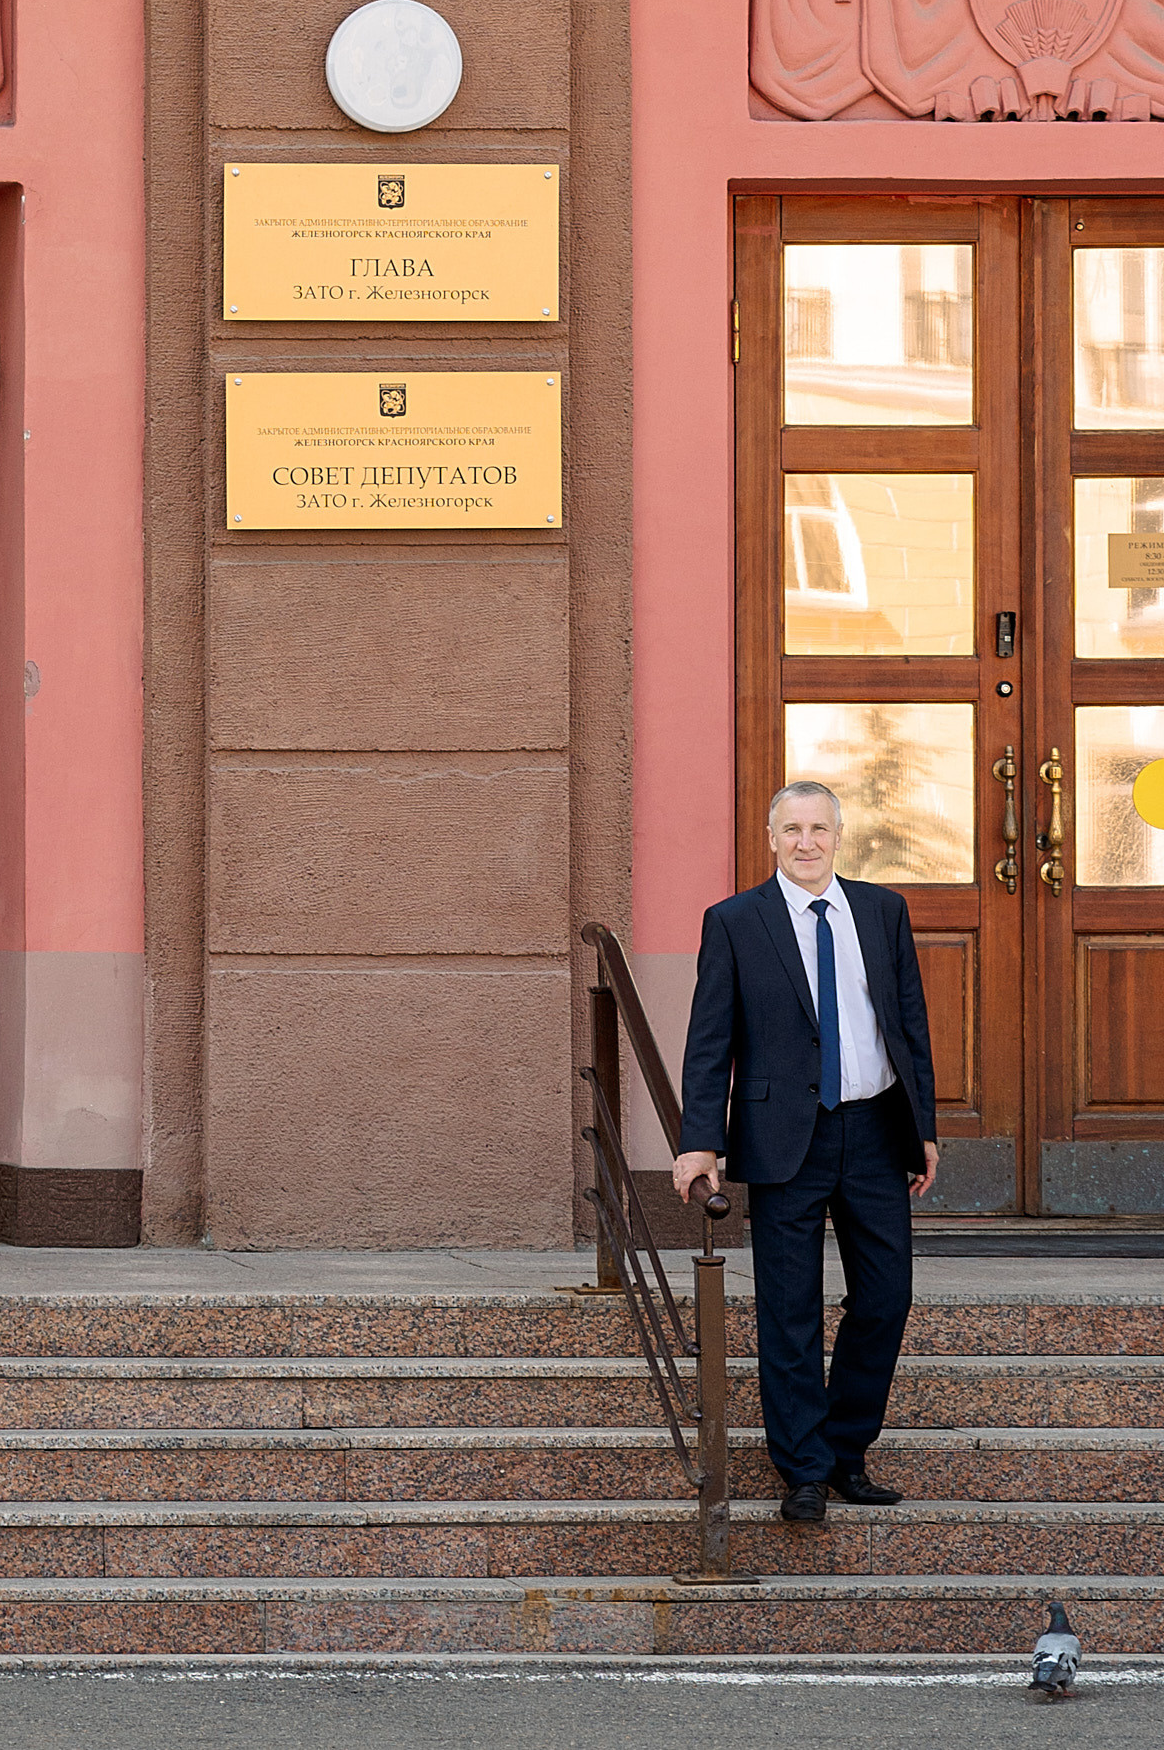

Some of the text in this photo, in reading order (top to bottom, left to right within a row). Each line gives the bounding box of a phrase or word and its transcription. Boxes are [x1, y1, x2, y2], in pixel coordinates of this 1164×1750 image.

[291, 230, 491, 239] ЖЕЛЕЗНОГОРСК КРАСНОЯРСКОГО КРАЯ
[349, 258, 435, 277] ГЛАВА
[292, 285, 490, 305] ЗАТО г. Железногорск
[294, 438, 495, 447] ЖЕЛЕЗНОГОРСК КРАСНОЯРСКОГО КРАЯ
[272, 466, 517, 489] СОВЕТ ДЕПУТАТОВ
[296, 493, 493, 513] ЗАТО г. Железногорск
